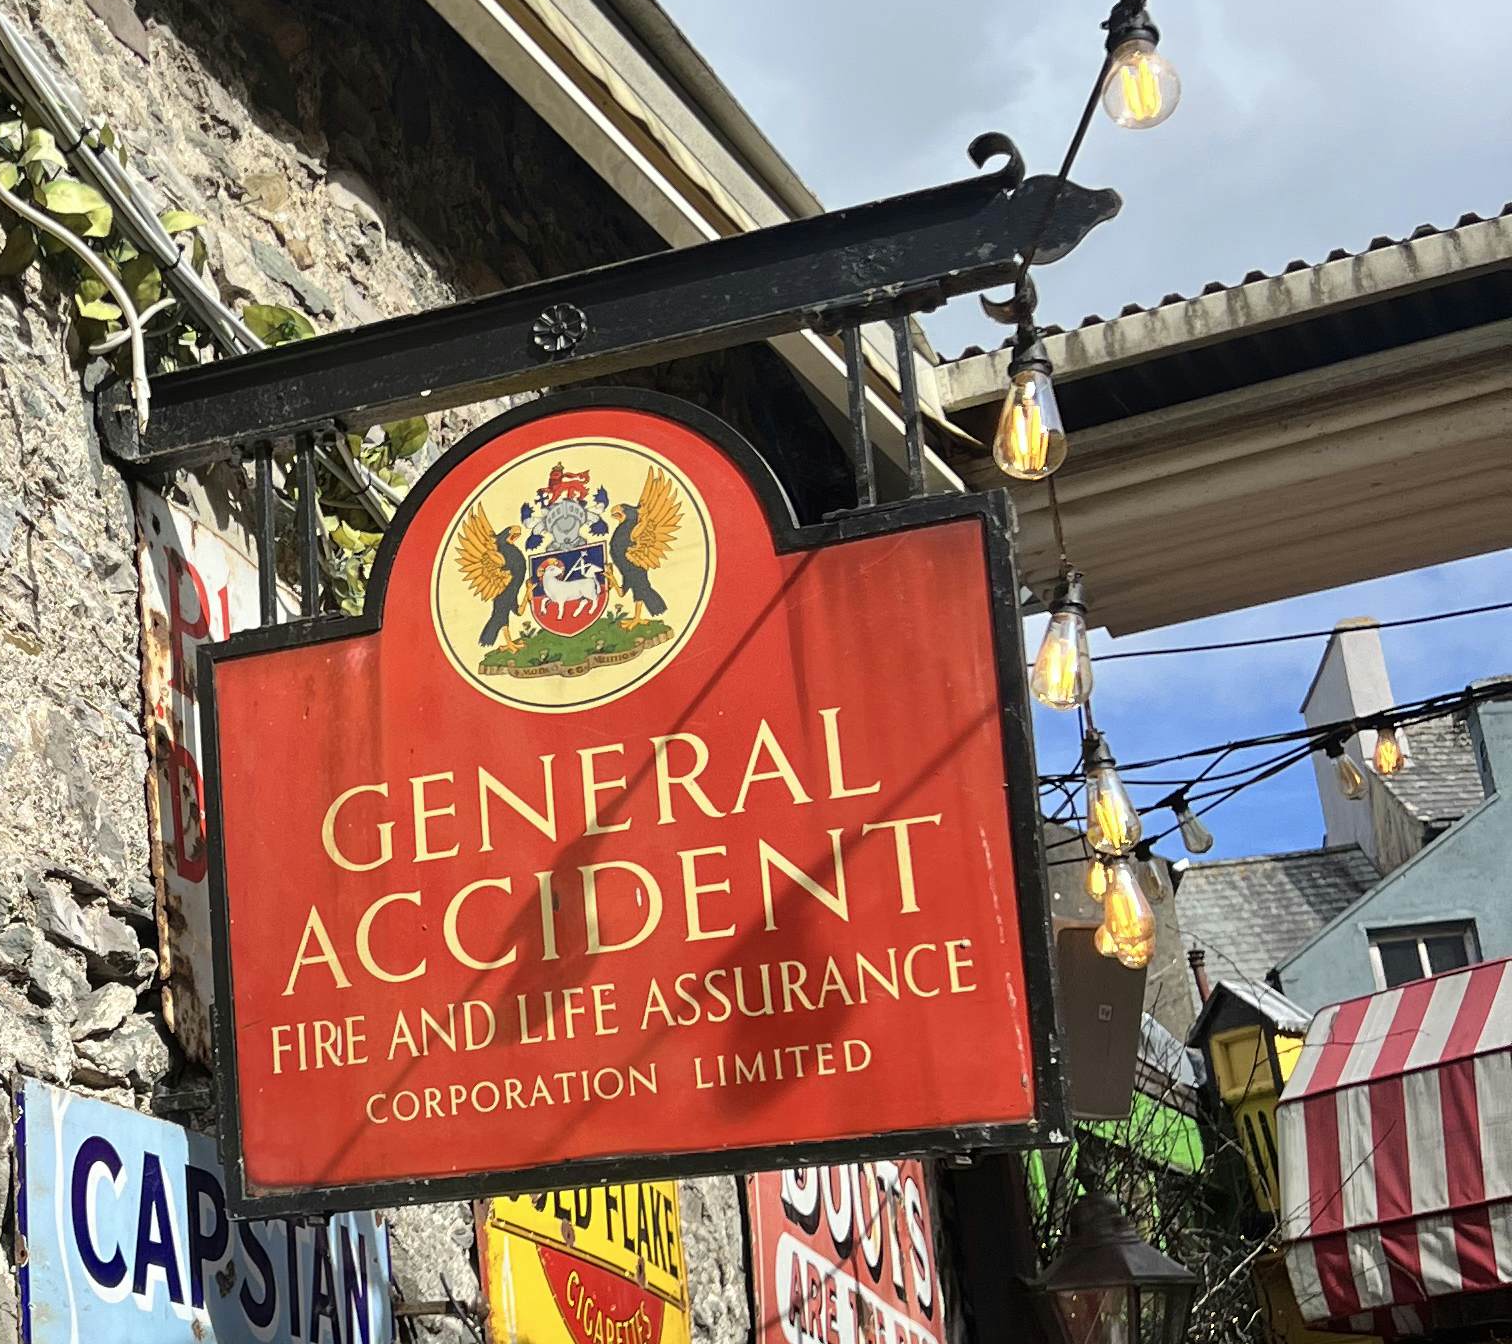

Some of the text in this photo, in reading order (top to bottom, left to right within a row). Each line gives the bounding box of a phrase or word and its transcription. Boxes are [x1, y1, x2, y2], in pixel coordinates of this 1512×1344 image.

[321, 706, 881, 873] GENERAL
[281, 812, 943, 997] ACCIDENT
[270, 937, 978, 1076] FIRE AND LIFE ASSURANCE
[365, 1038, 873, 1125] CORPORATION LIMITED
[605, 1179, 680, 1281] FLAKE
